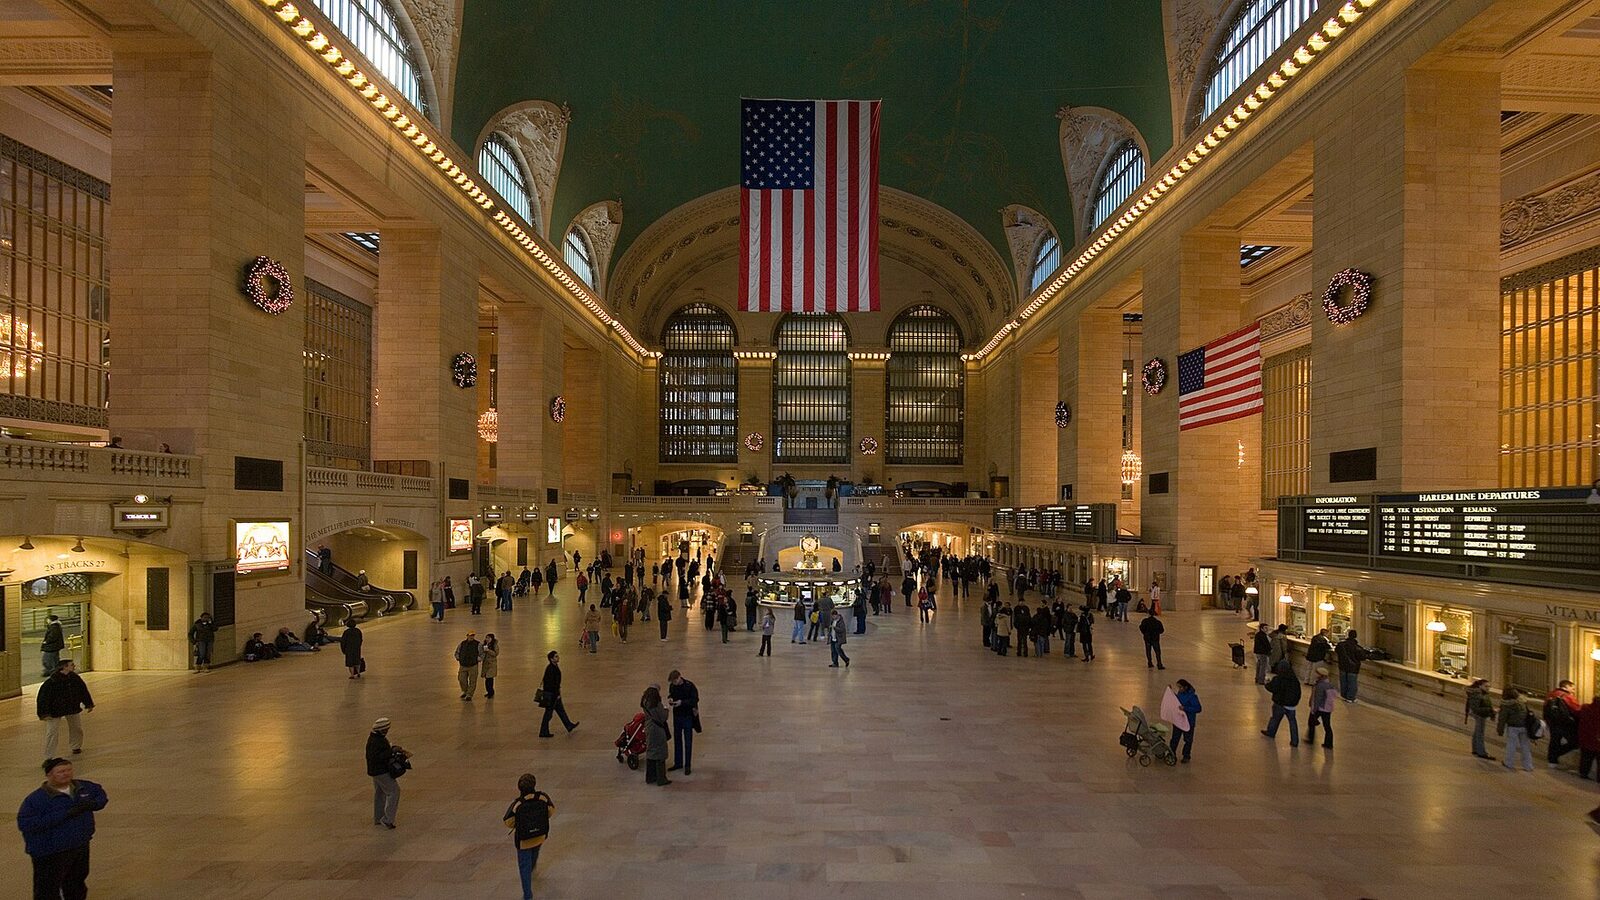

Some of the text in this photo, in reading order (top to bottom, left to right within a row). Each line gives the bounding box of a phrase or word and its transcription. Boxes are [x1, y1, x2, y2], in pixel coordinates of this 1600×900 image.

[1478, 491, 1540, 500] DEPARTURES
[399, 520, 415, 528] STREET
[307, 518, 370, 542] THE METLIFE BUILDING
[57, 561, 94, 570] TRACKS
[1545, 604, 1578, 619] MTA
